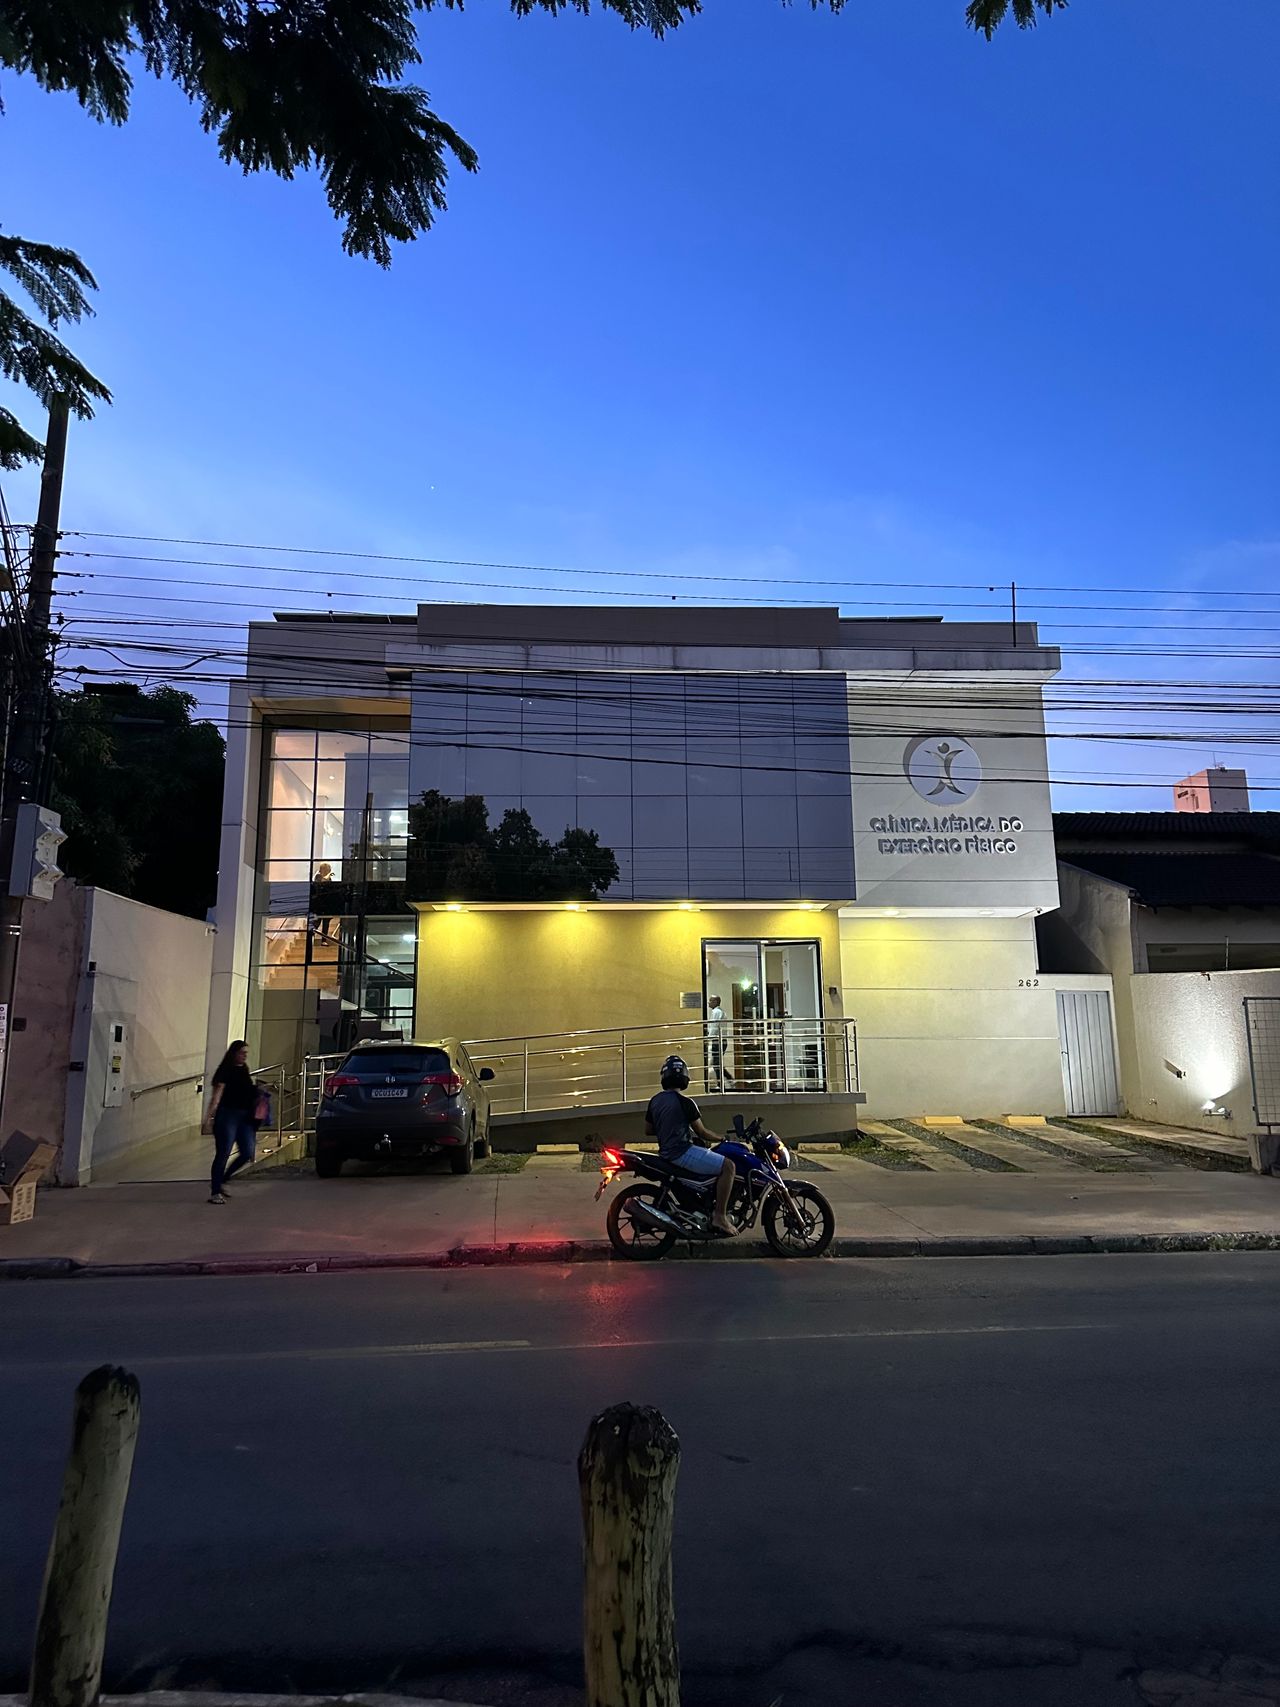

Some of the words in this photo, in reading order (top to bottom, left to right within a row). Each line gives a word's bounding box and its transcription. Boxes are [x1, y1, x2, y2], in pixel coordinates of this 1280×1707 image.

[937, 814, 996, 833] MÉDICA
[1000, 818, 1023, 833] DO
[879, 837, 962, 854] EXERCÍCIO
[967, 836, 1017, 854] FÍSICO
[1018, 979, 1039, 987] 262
